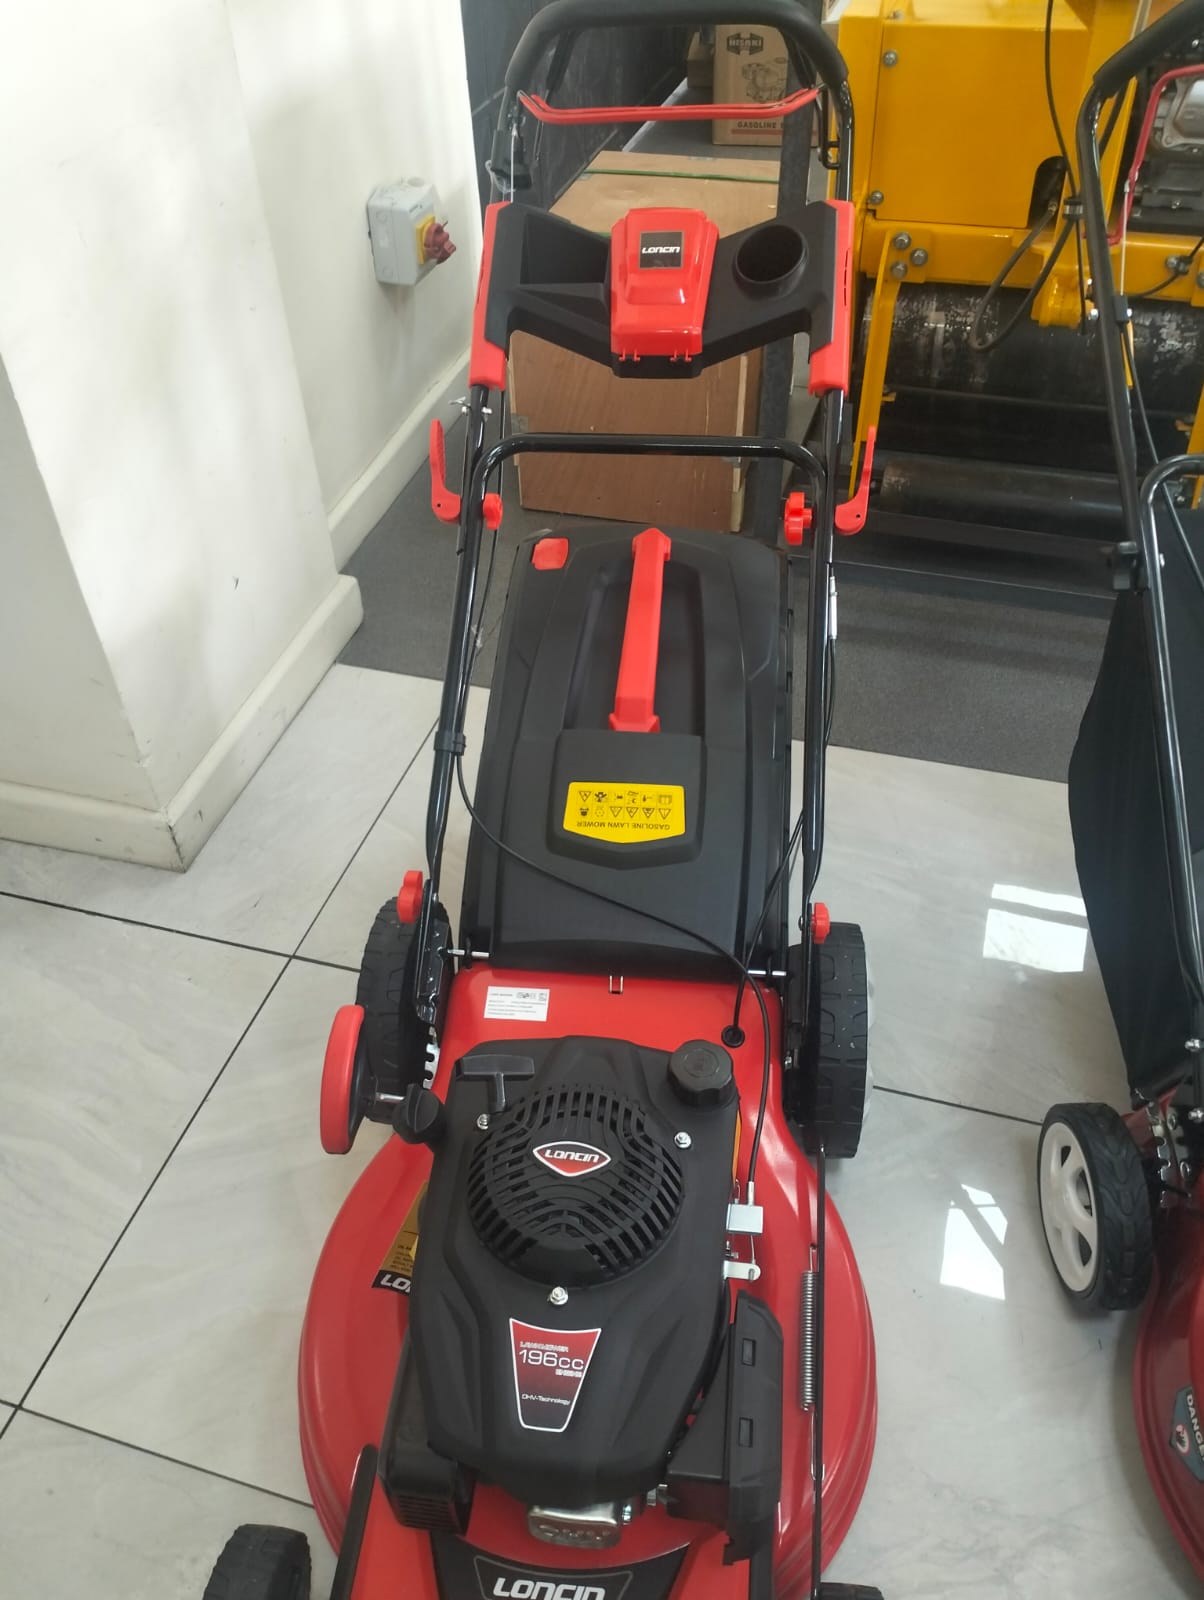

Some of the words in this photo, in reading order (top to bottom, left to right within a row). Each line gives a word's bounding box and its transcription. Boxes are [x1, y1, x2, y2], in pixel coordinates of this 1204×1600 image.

[737, 121, 777, 129] GASOLINE
[642, 246, 681, 254] LONCIN
[577, 820, 606, 828] MOWER
[608, 821, 629, 829] LAWN
[632, 822, 670, 831] GASOLINE
[545, 1149, 599, 1163] LONCIN
[380, 1273, 412, 1293] LO
[519, 1349, 584, 1370] 196cc
[493, 1577, 606, 1600] LONCIN
